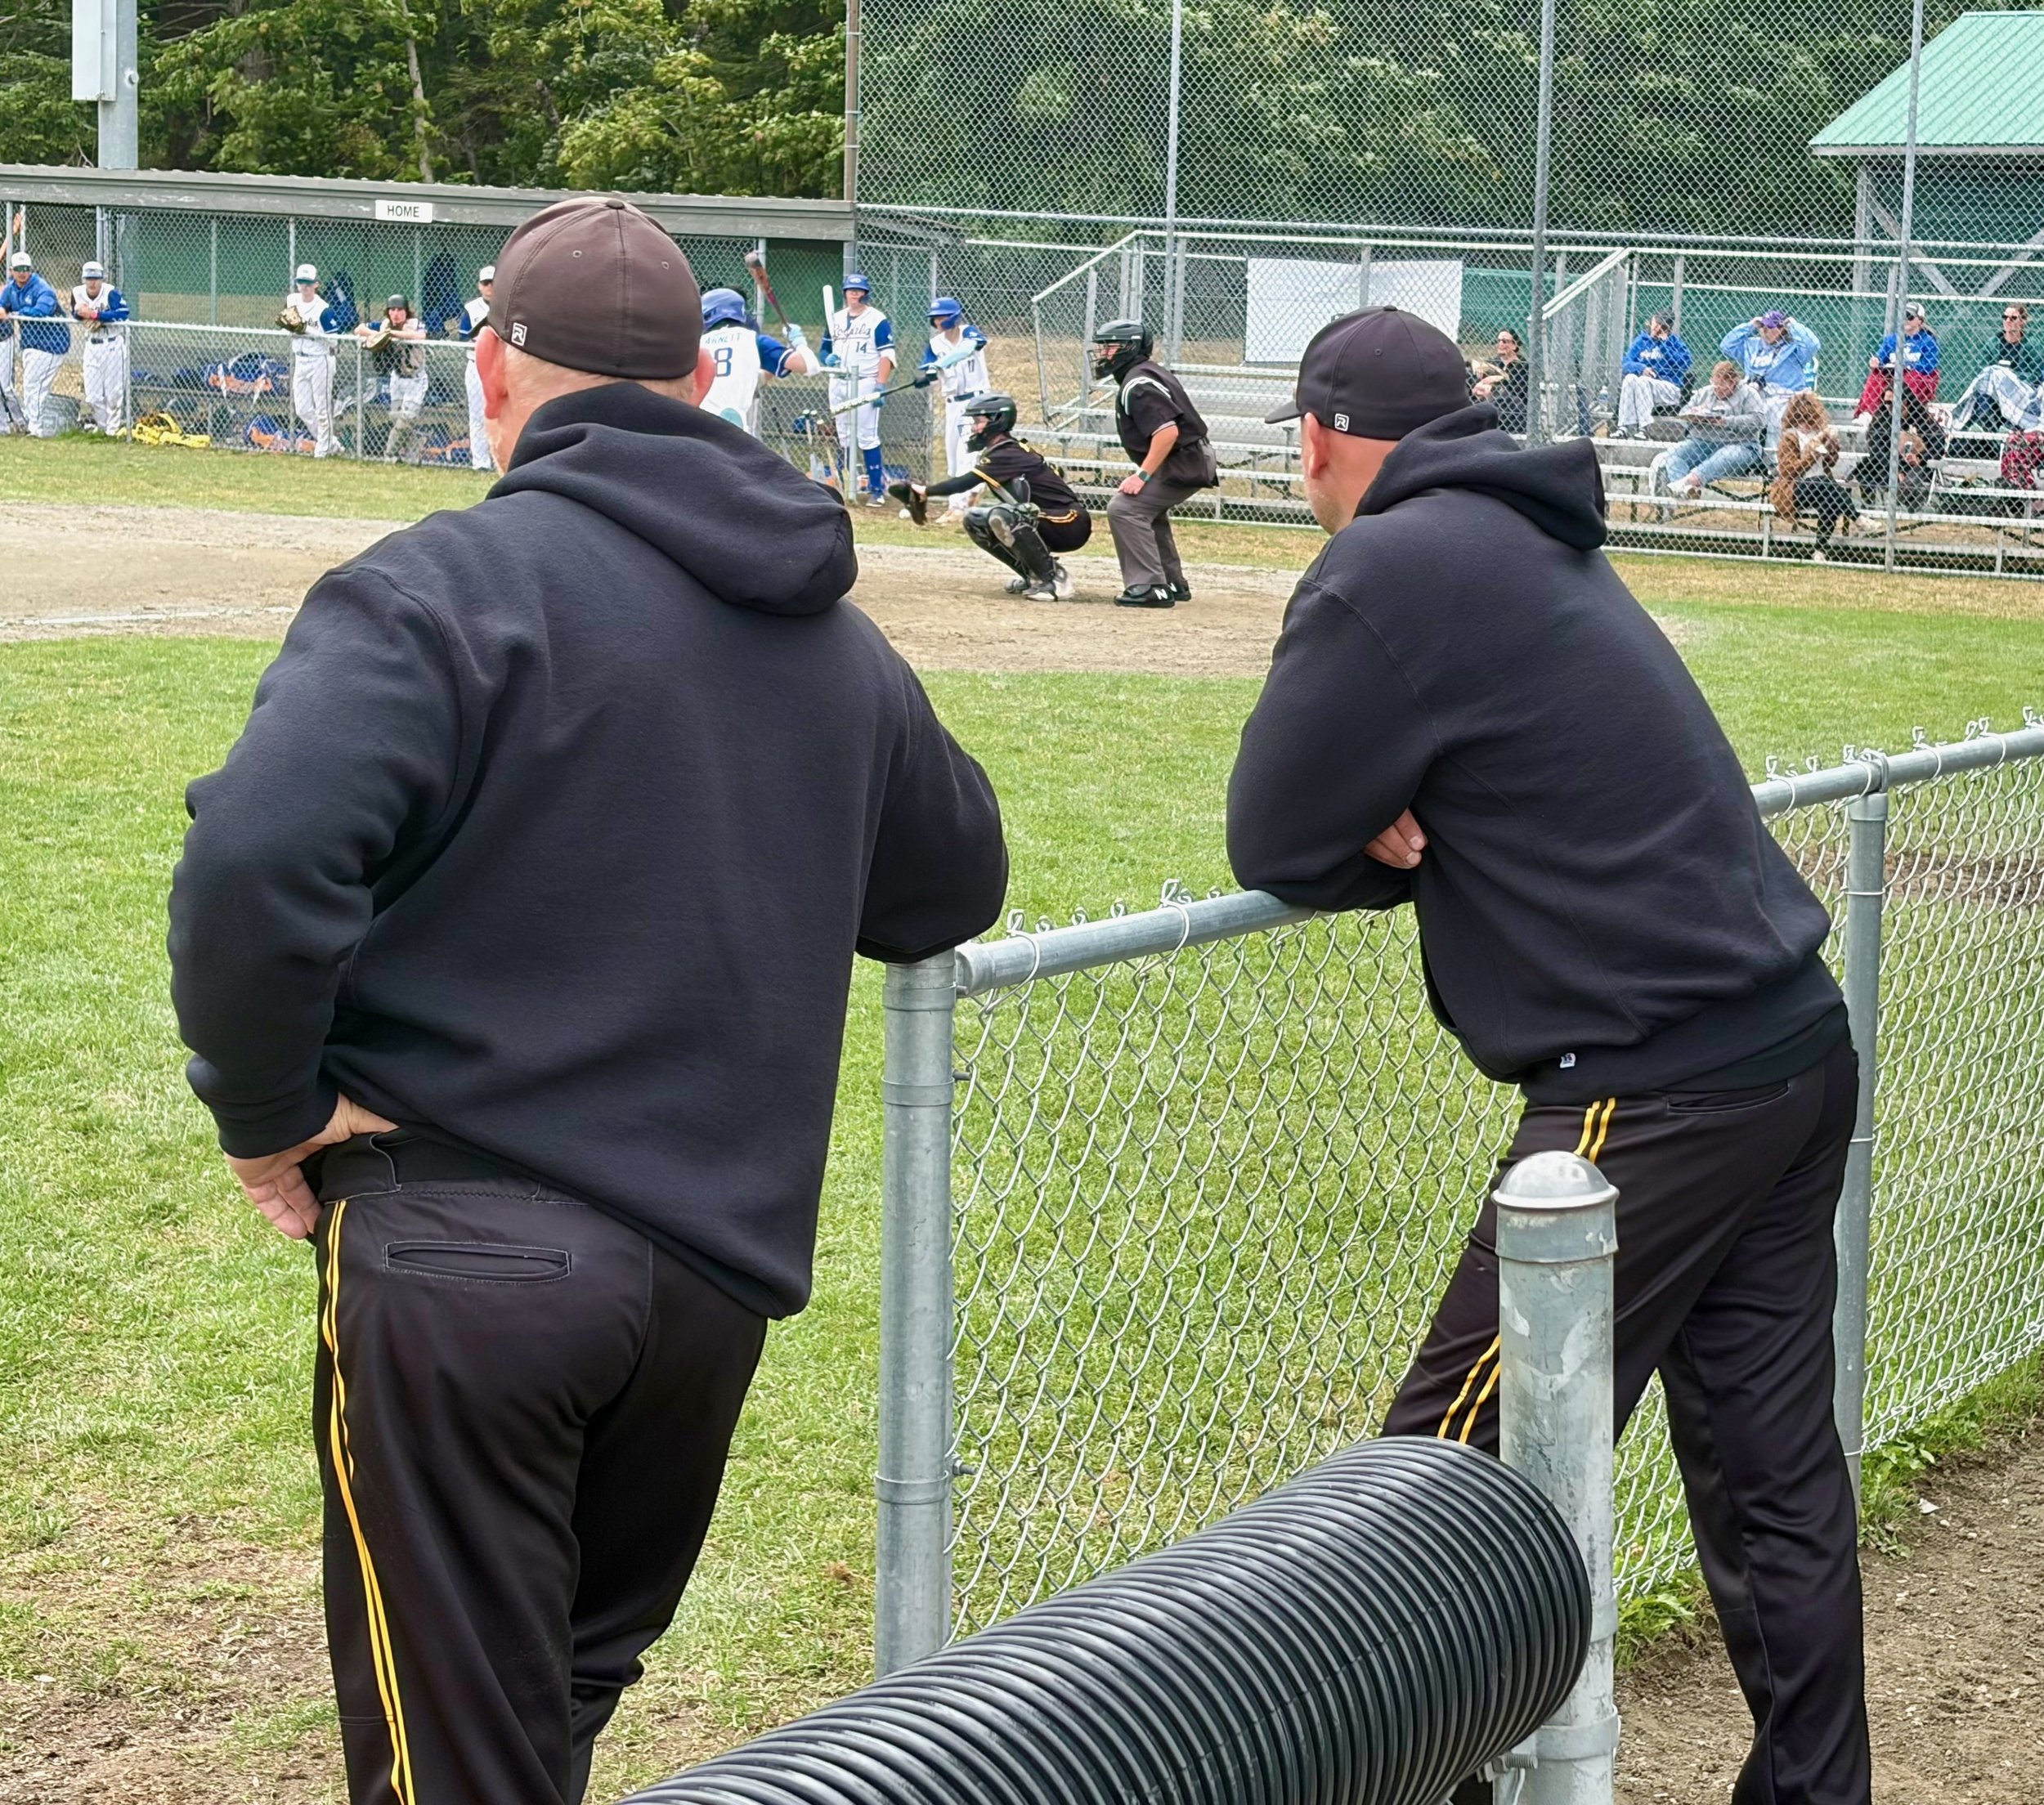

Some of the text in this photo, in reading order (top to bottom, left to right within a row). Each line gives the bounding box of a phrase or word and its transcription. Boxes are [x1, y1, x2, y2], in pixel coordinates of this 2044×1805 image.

[387, 205, 419, 217] HOME
[855, 342, 867, 353] 14
[714, 347, 733, 377] 8
[1154, 589, 1168, 600] N
